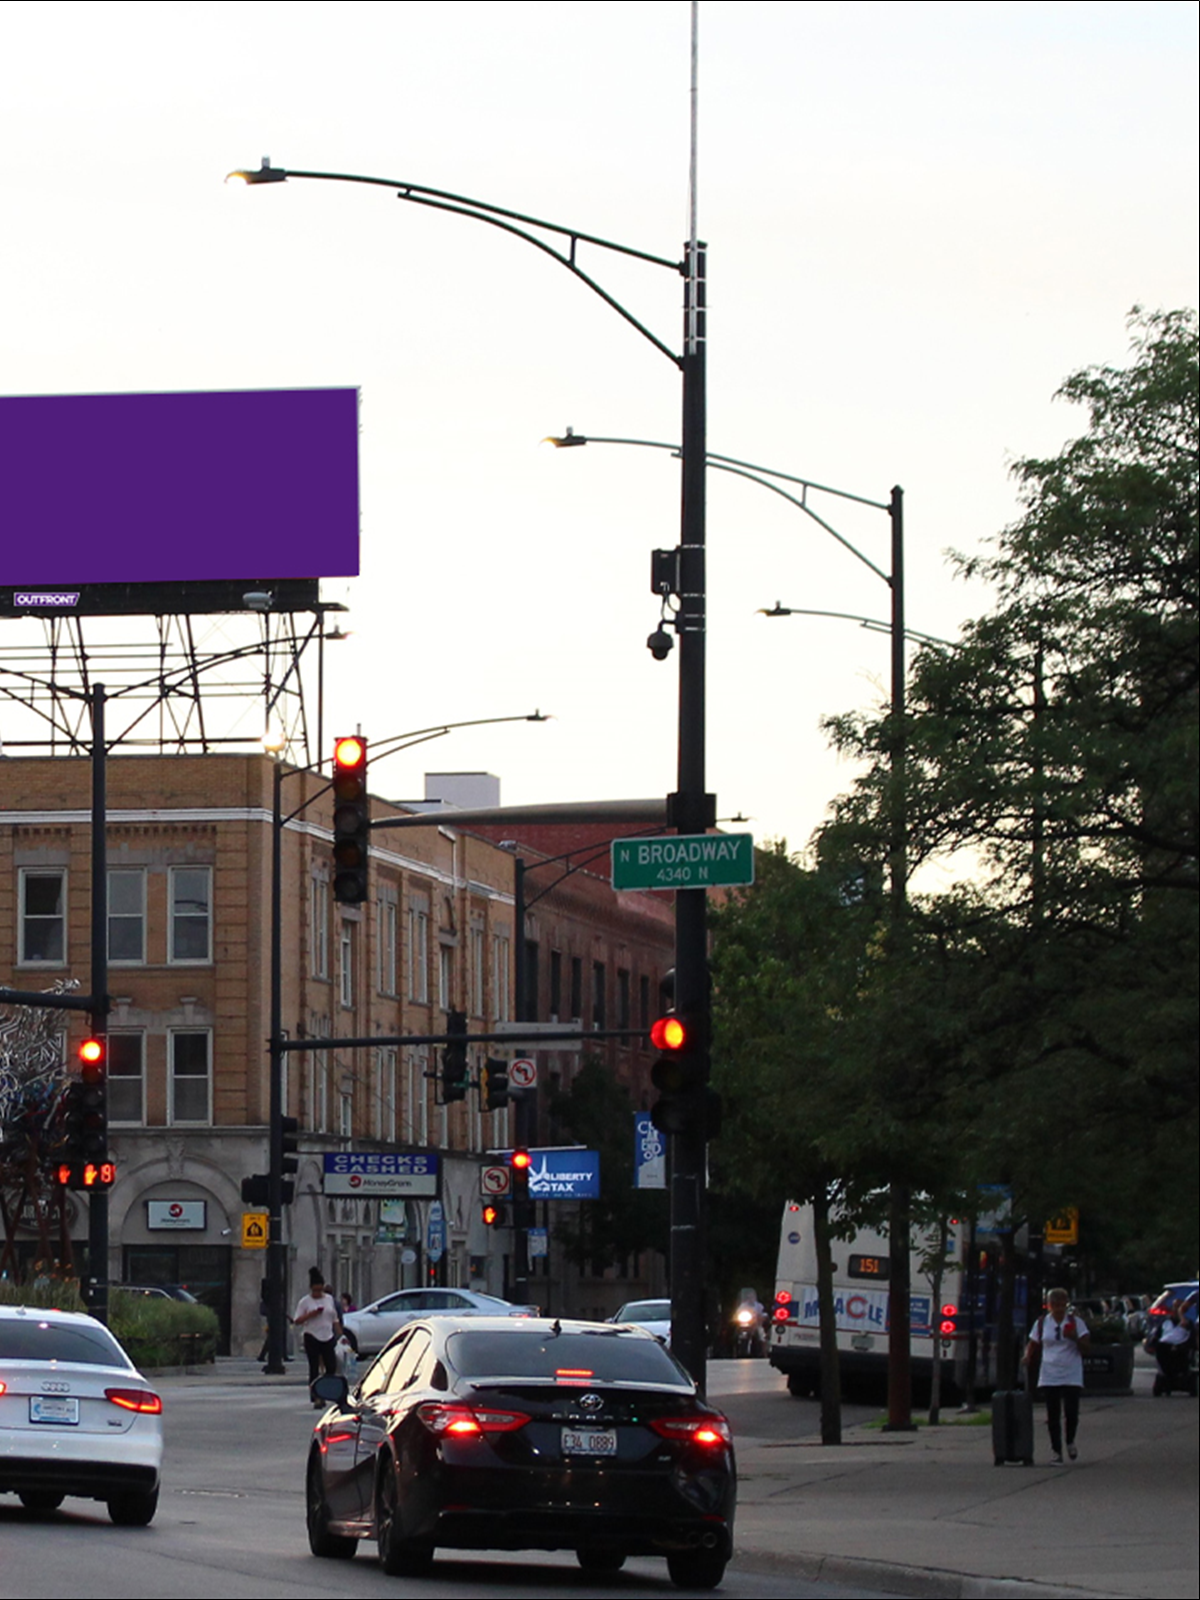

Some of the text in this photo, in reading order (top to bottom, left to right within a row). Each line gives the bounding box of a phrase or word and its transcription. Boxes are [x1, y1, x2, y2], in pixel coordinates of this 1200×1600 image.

[17, 594, 75, 605] OUTFRONT
[621, 841, 741, 864] N BROADWAY
[657, 867, 708, 881] 4340 N
[334, 1155, 428, 1165] CHECKS
[334, 1164, 428, 1174] CASHED
[551, 1172, 593, 1181] LIBERTY
[363, 1179, 412, 1188] MoneyGram
[551, 1182, 574, 1192] TAX
[859, 1258, 880, 1273] 151
[805, 1296, 883, 1325] MACLE
